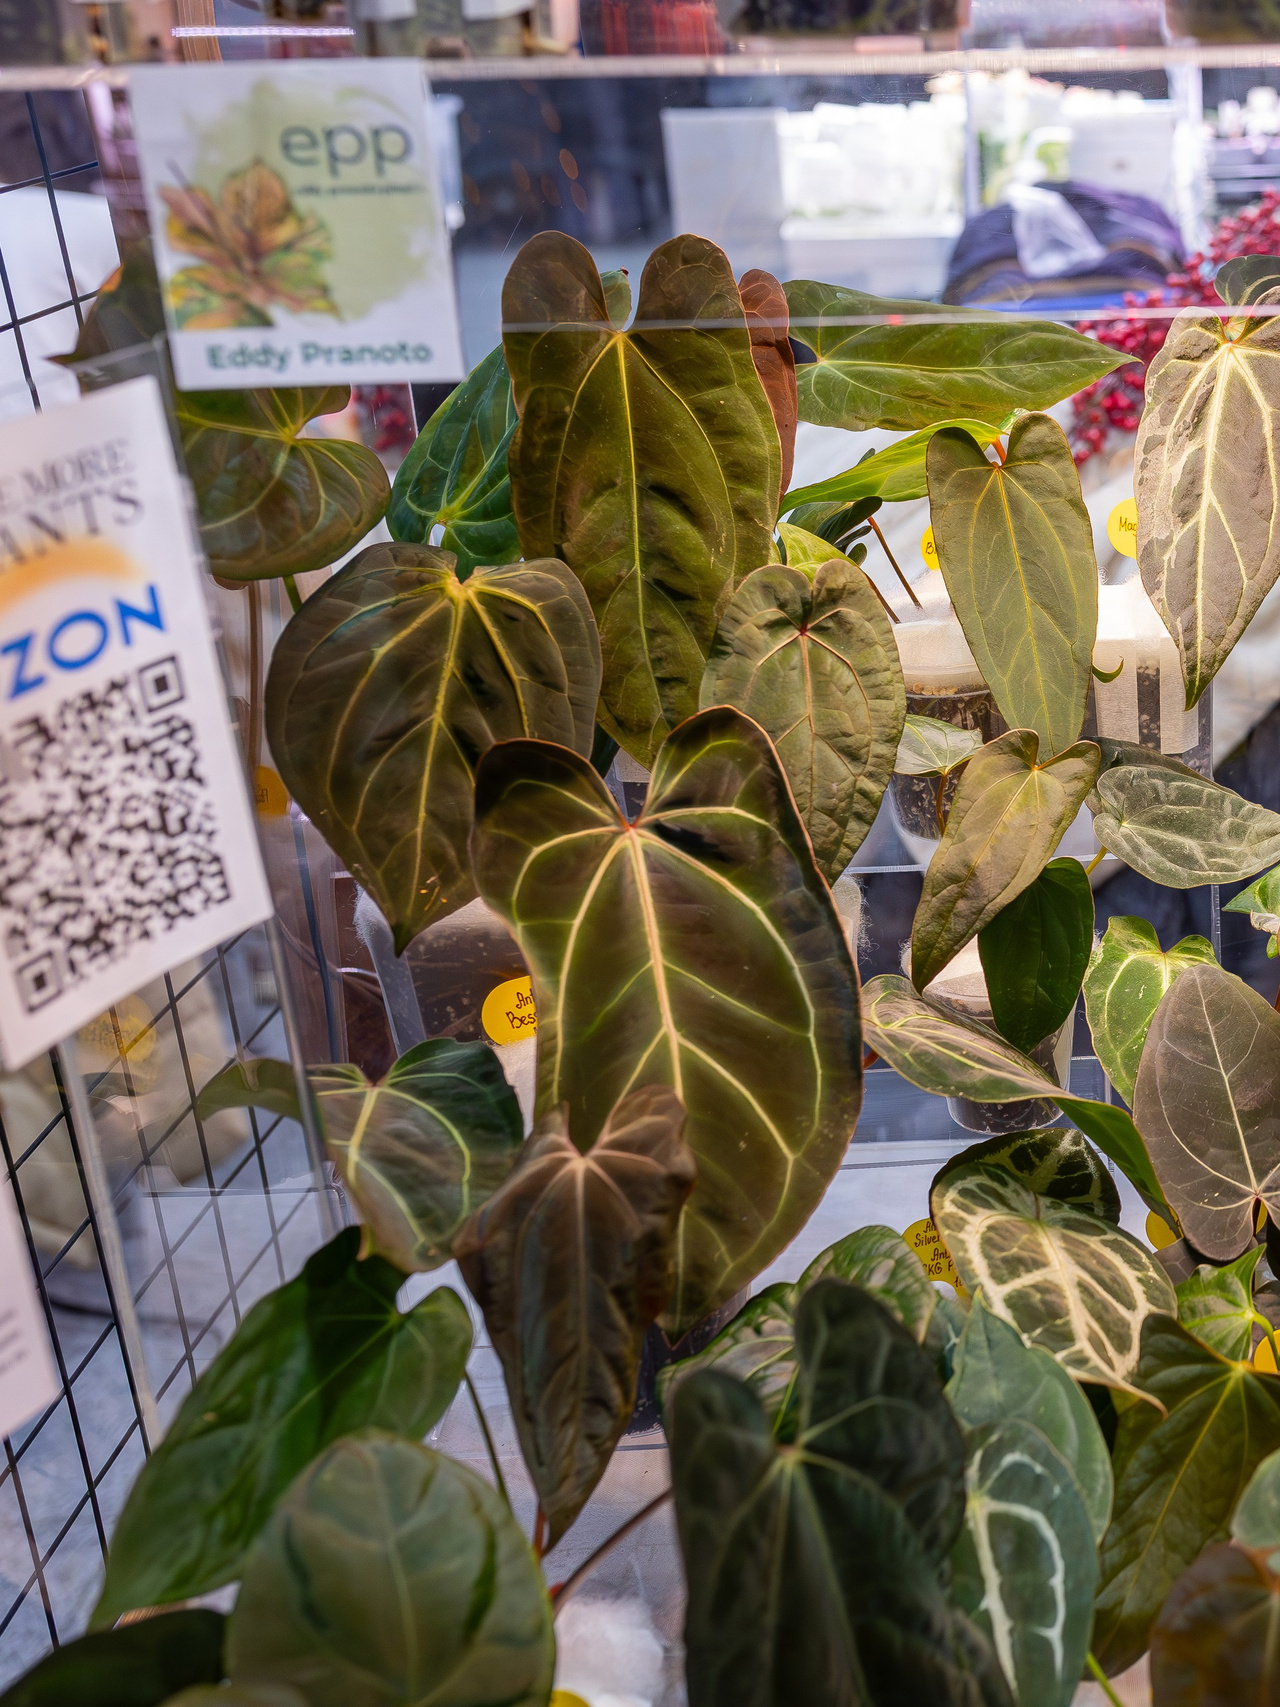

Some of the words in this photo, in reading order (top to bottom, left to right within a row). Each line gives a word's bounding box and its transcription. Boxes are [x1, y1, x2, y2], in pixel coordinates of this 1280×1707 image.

[279, 123, 414, 178] epp
[206, 342, 291, 374] Eddy
[300, 339, 433, 366] Pranoto
[22, 439, 133, 492] MORE
[0, 583, 166, 700] ZON
